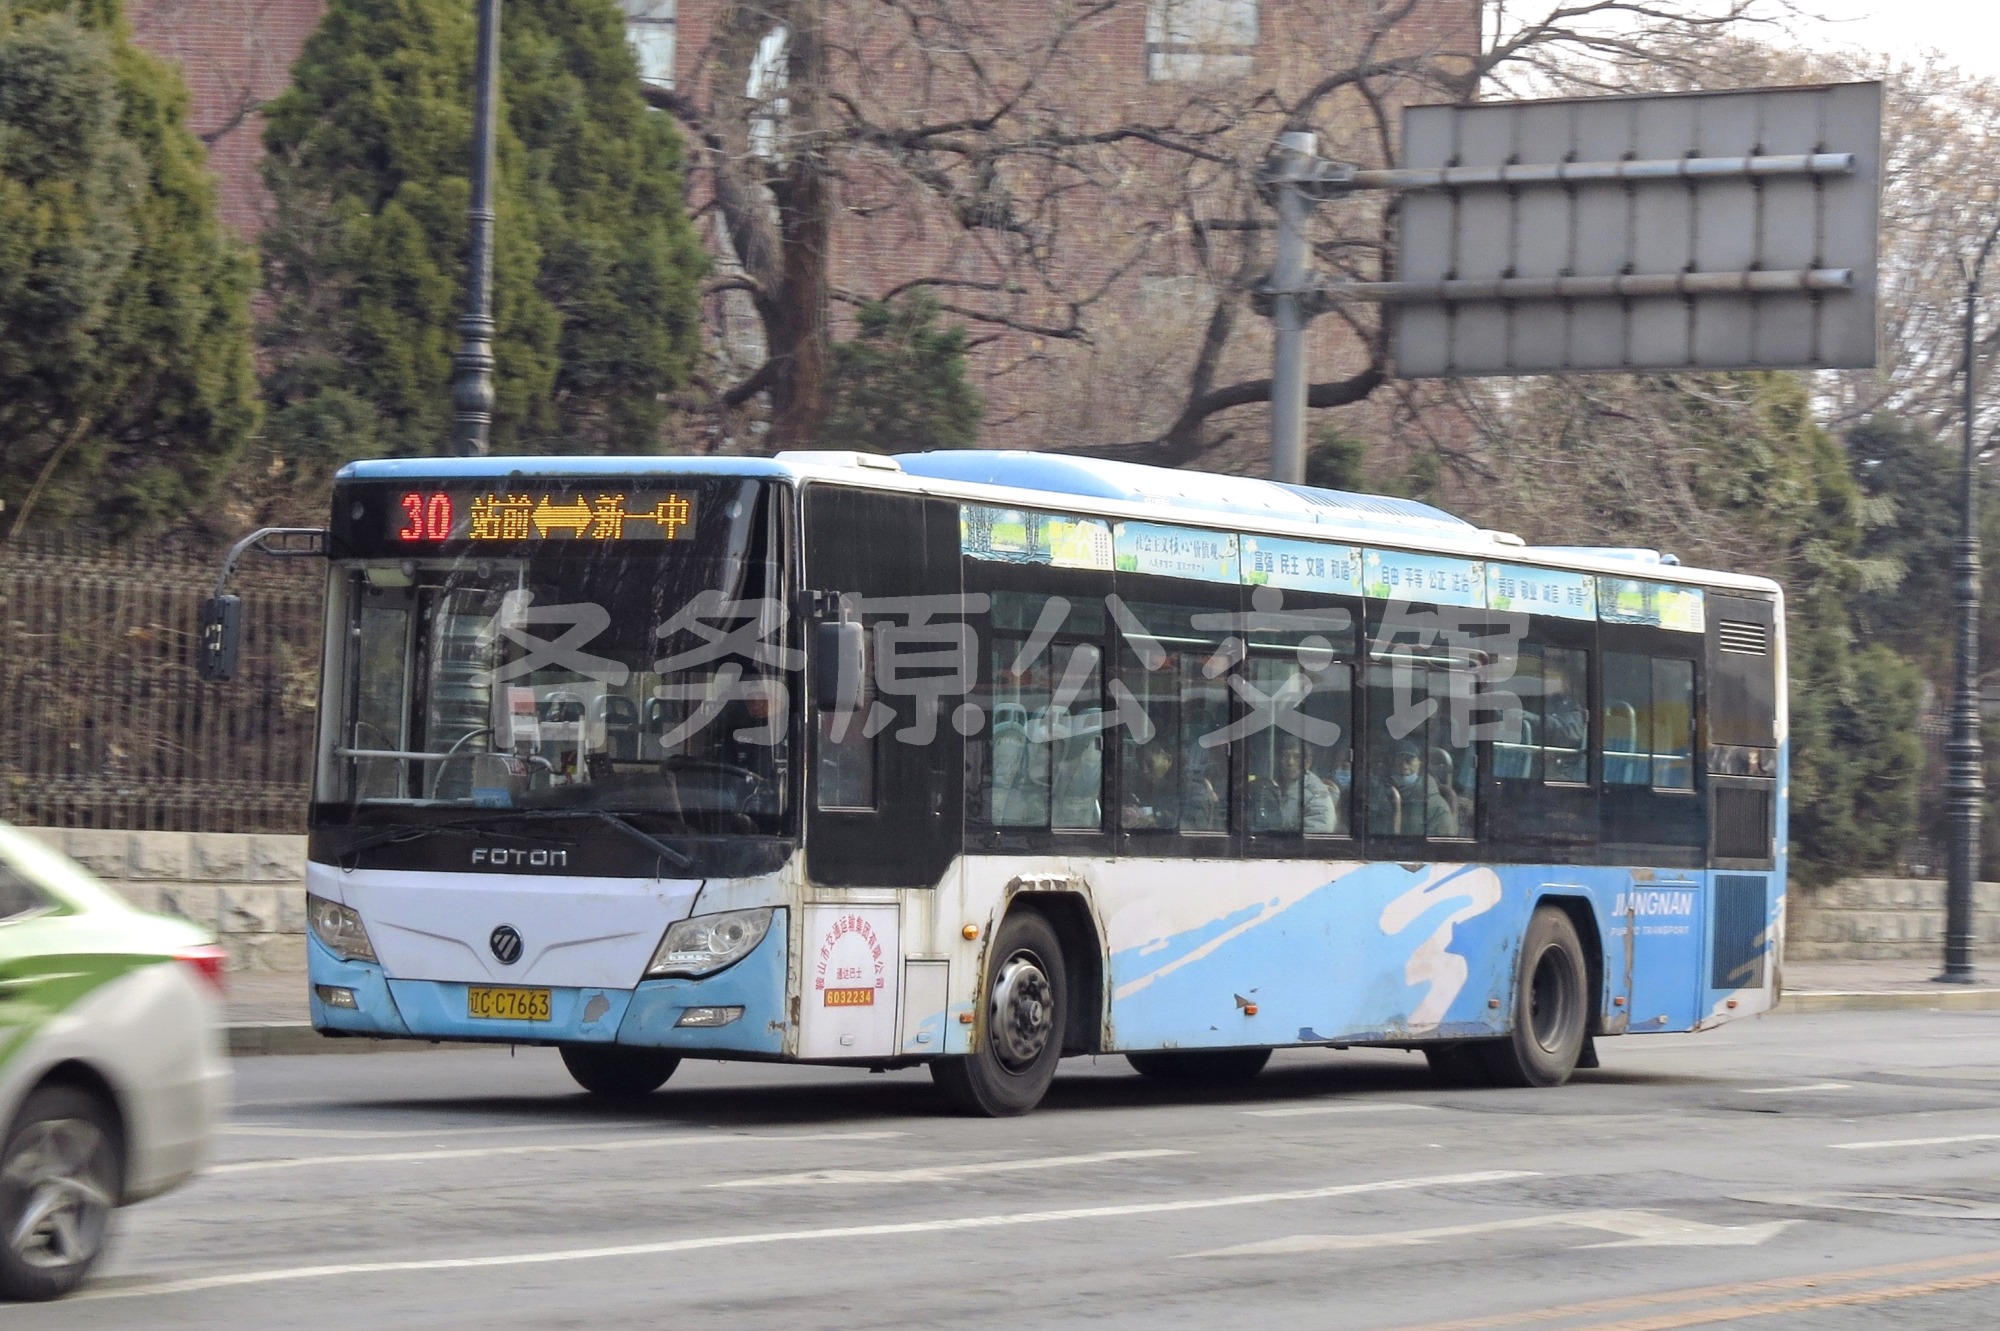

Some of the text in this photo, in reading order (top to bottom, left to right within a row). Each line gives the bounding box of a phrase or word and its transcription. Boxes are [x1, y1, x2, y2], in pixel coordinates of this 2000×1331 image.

[401, 494, 451, 540] 30
[469, 494, 533, 539] 站前
[1135, 532, 1218, 560] 社会主义核心价值观
[1254, 550, 1350, 581] 富强 民主 文明 和谐
[1382, 564, 1469, 593] 自由 平等 公正 法治
[472, 848, 567, 866] FOTON
[1611, 891, 1692, 917] JIANGNAN
[815, 914, 884, 990] 鞍山市交通运输集团有限公司
[836, 967, 862, 980] 通达巴士
[827, 990, 871, 1004] 6032234
